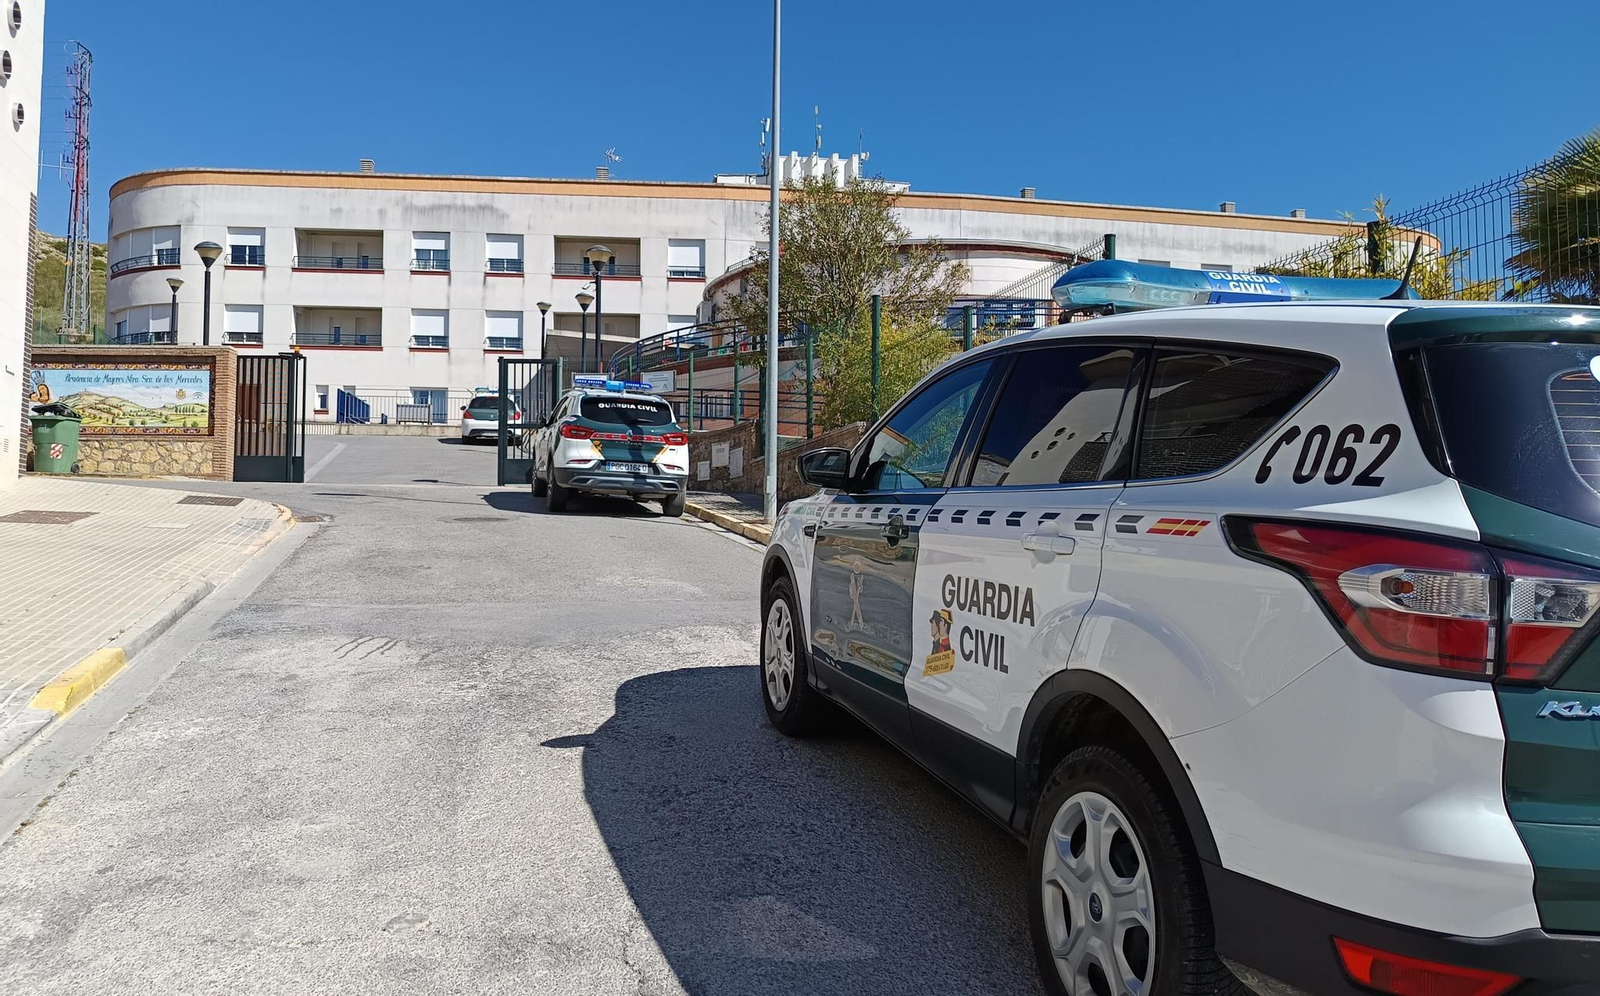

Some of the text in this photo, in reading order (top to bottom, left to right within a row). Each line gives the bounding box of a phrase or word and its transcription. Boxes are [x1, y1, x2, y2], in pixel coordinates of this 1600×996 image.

[1208, 271, 1281, 284] GUARDIA
[1228, 281, 1272, 295] CIVIL
[94, 375, 101, 383] de
[155, 374, 163, 383] de
[598, 402, 658, 413] GUARDIA CIVIL
[1292, 423, 1402, 487] 062
[610, 462, 624, 471] PGC
[624, 464, 641, 472] 0164
[941, 573, 1036, 628] GUARDIA
[959, 625, 1009, 675] CIVIL
